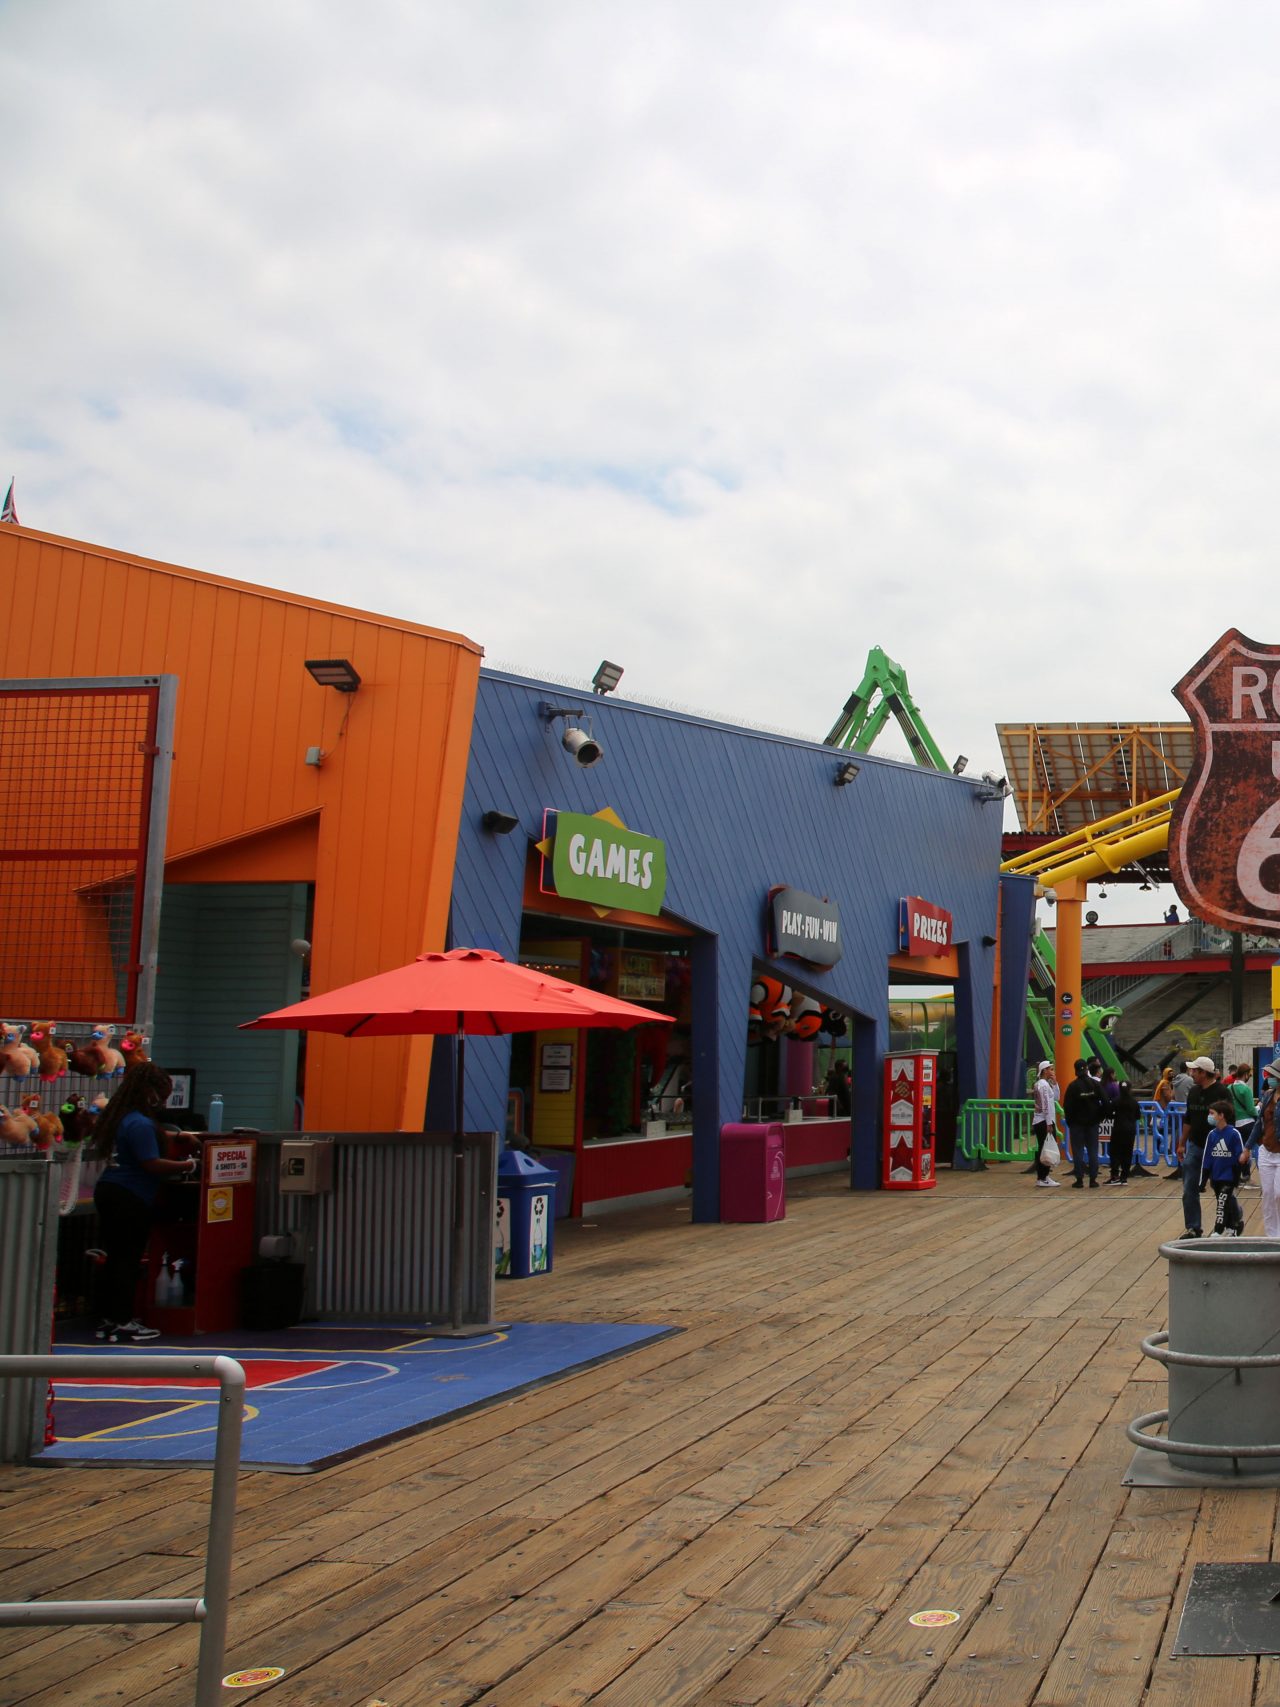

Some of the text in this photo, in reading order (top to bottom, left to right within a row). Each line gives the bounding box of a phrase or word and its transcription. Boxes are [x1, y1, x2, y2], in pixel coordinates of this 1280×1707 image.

[569, 833, 654, 890] GAMES
[914, 912, 948, 945] PRIZES
[217, 1150, 247, 1161] SPECIAL
